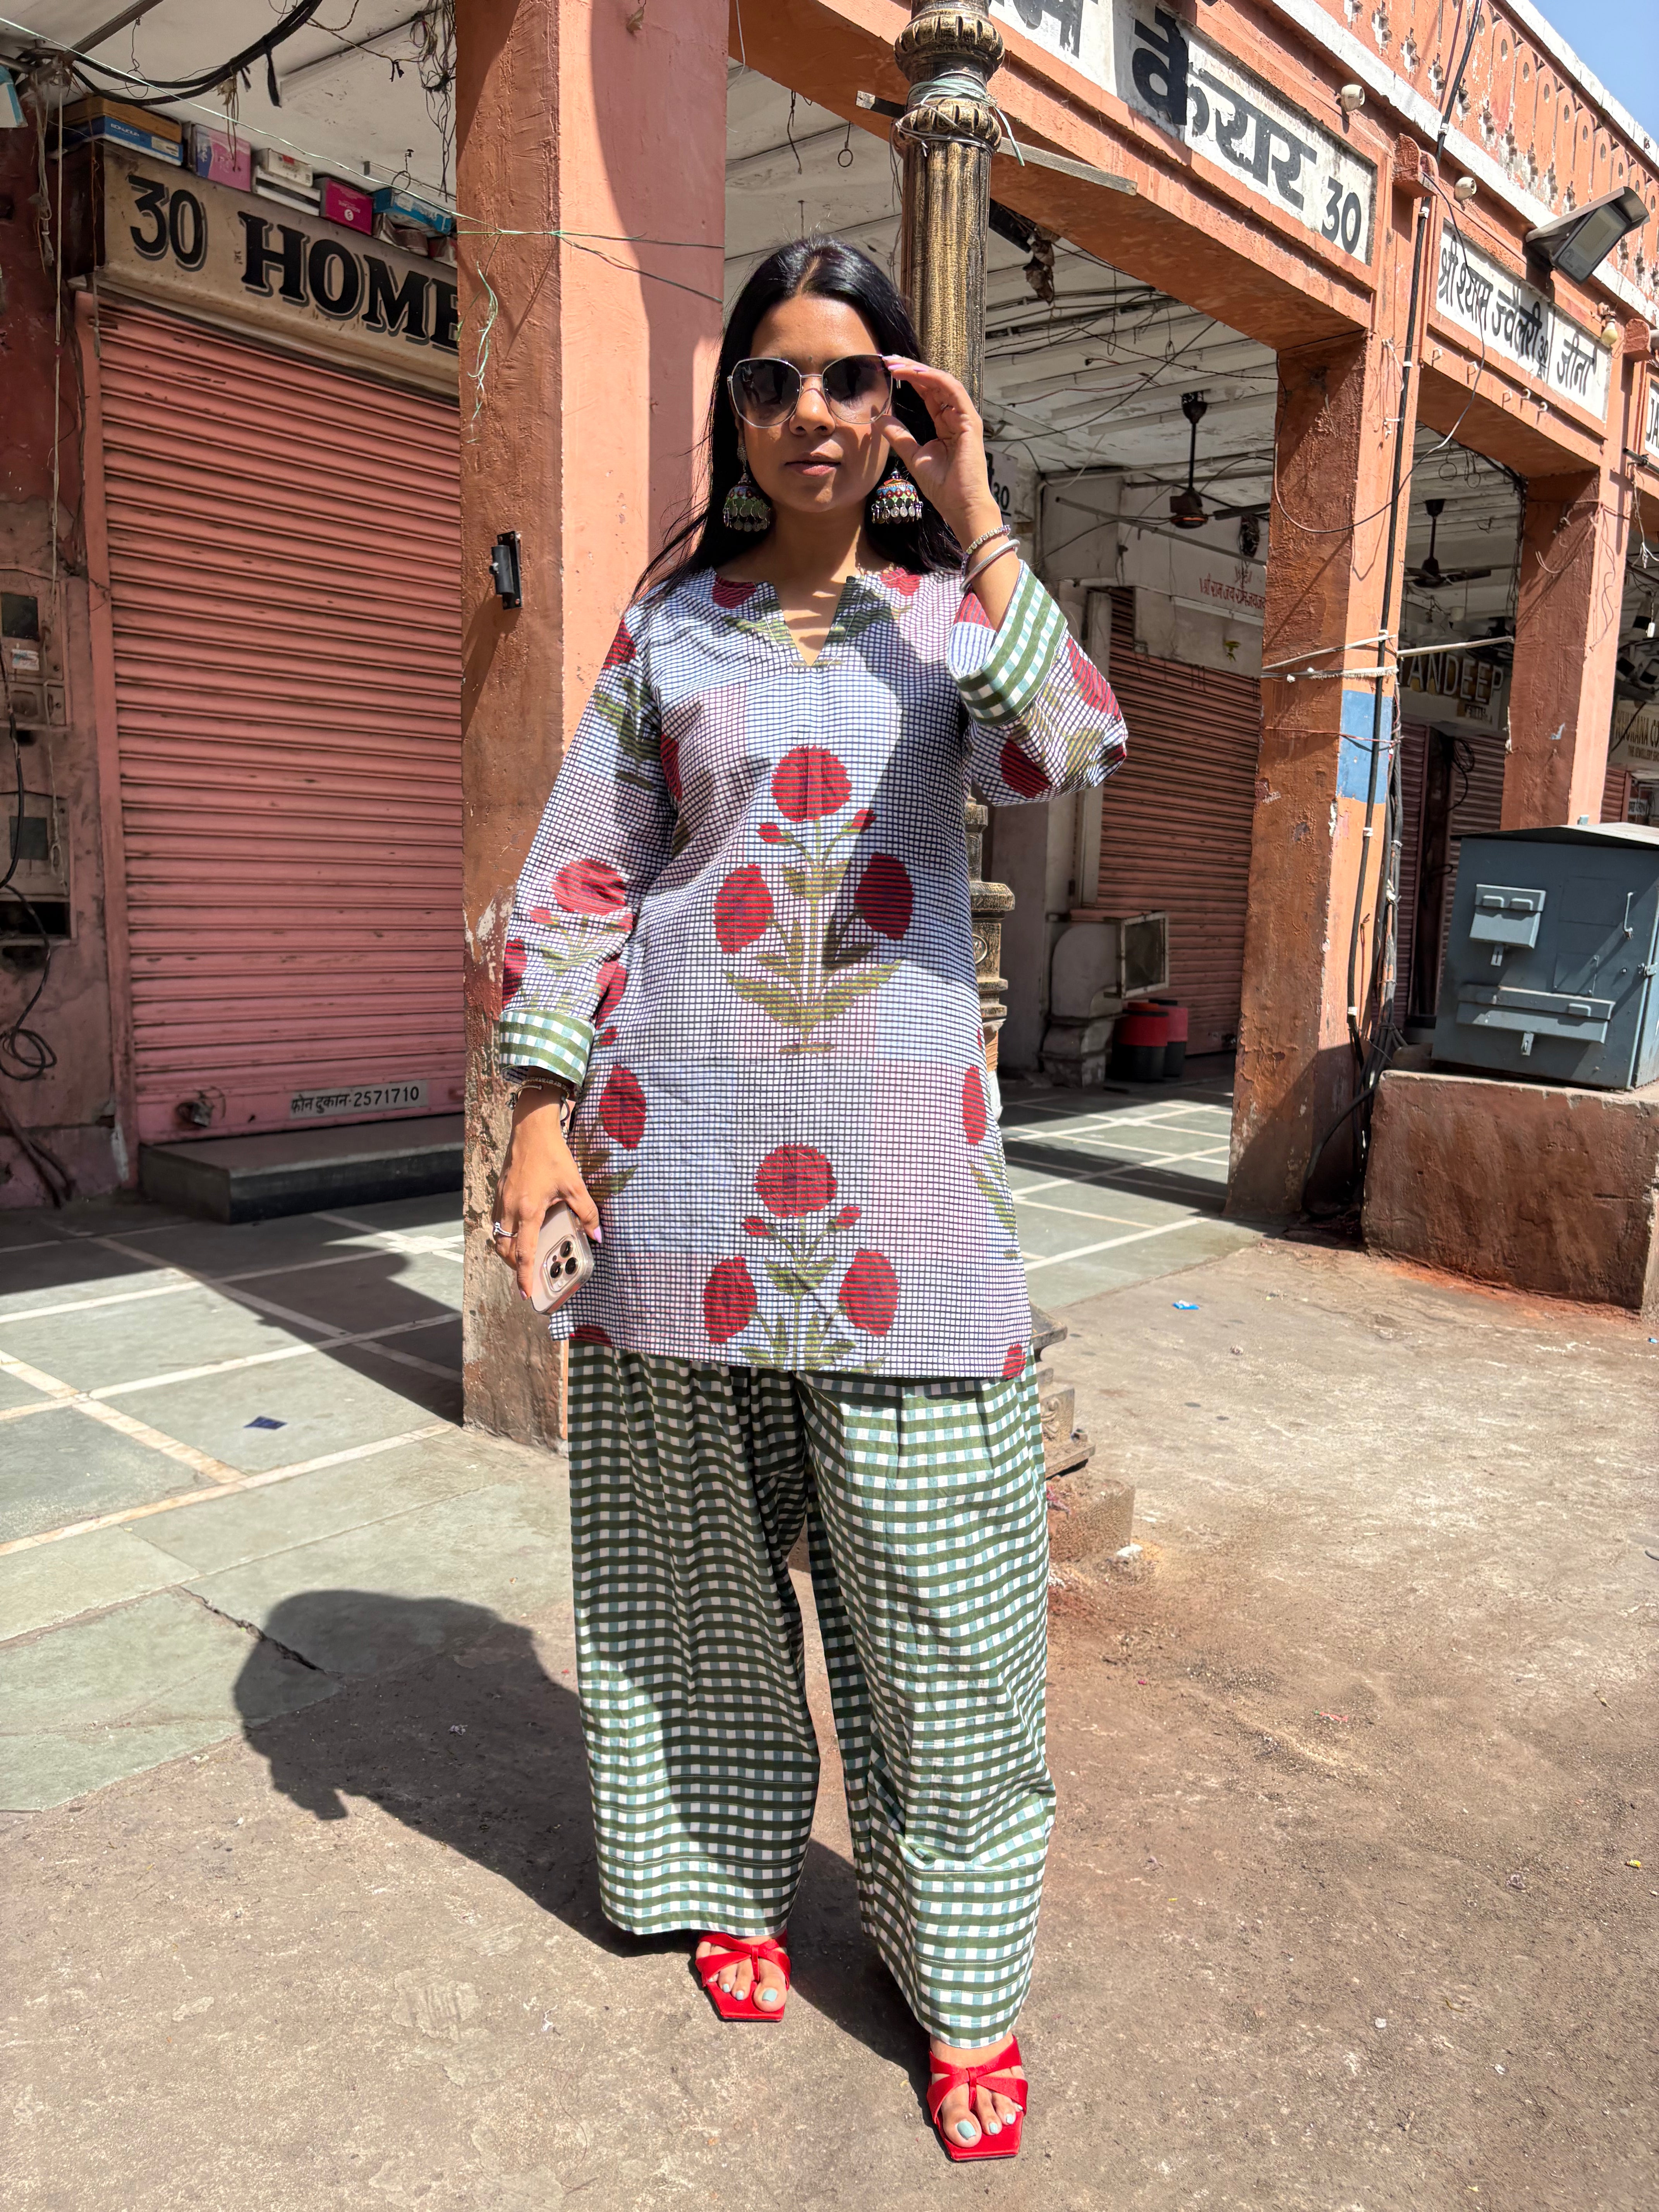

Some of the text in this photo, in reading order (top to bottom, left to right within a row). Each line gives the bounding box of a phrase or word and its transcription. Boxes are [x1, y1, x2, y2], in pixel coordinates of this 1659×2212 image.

[1321, 175, 1362, 254] 30
[128, 174, 459, 350] 30 HOME
[1438, 234, 1459, 307] श्री
[1456, 262, 1494, 331] श्याम
[1399, 649, 1504, 704] ANDEEP
[291, 1093, 313, 1113] फोन
[354, 1086, 419, 1107] 2571710
